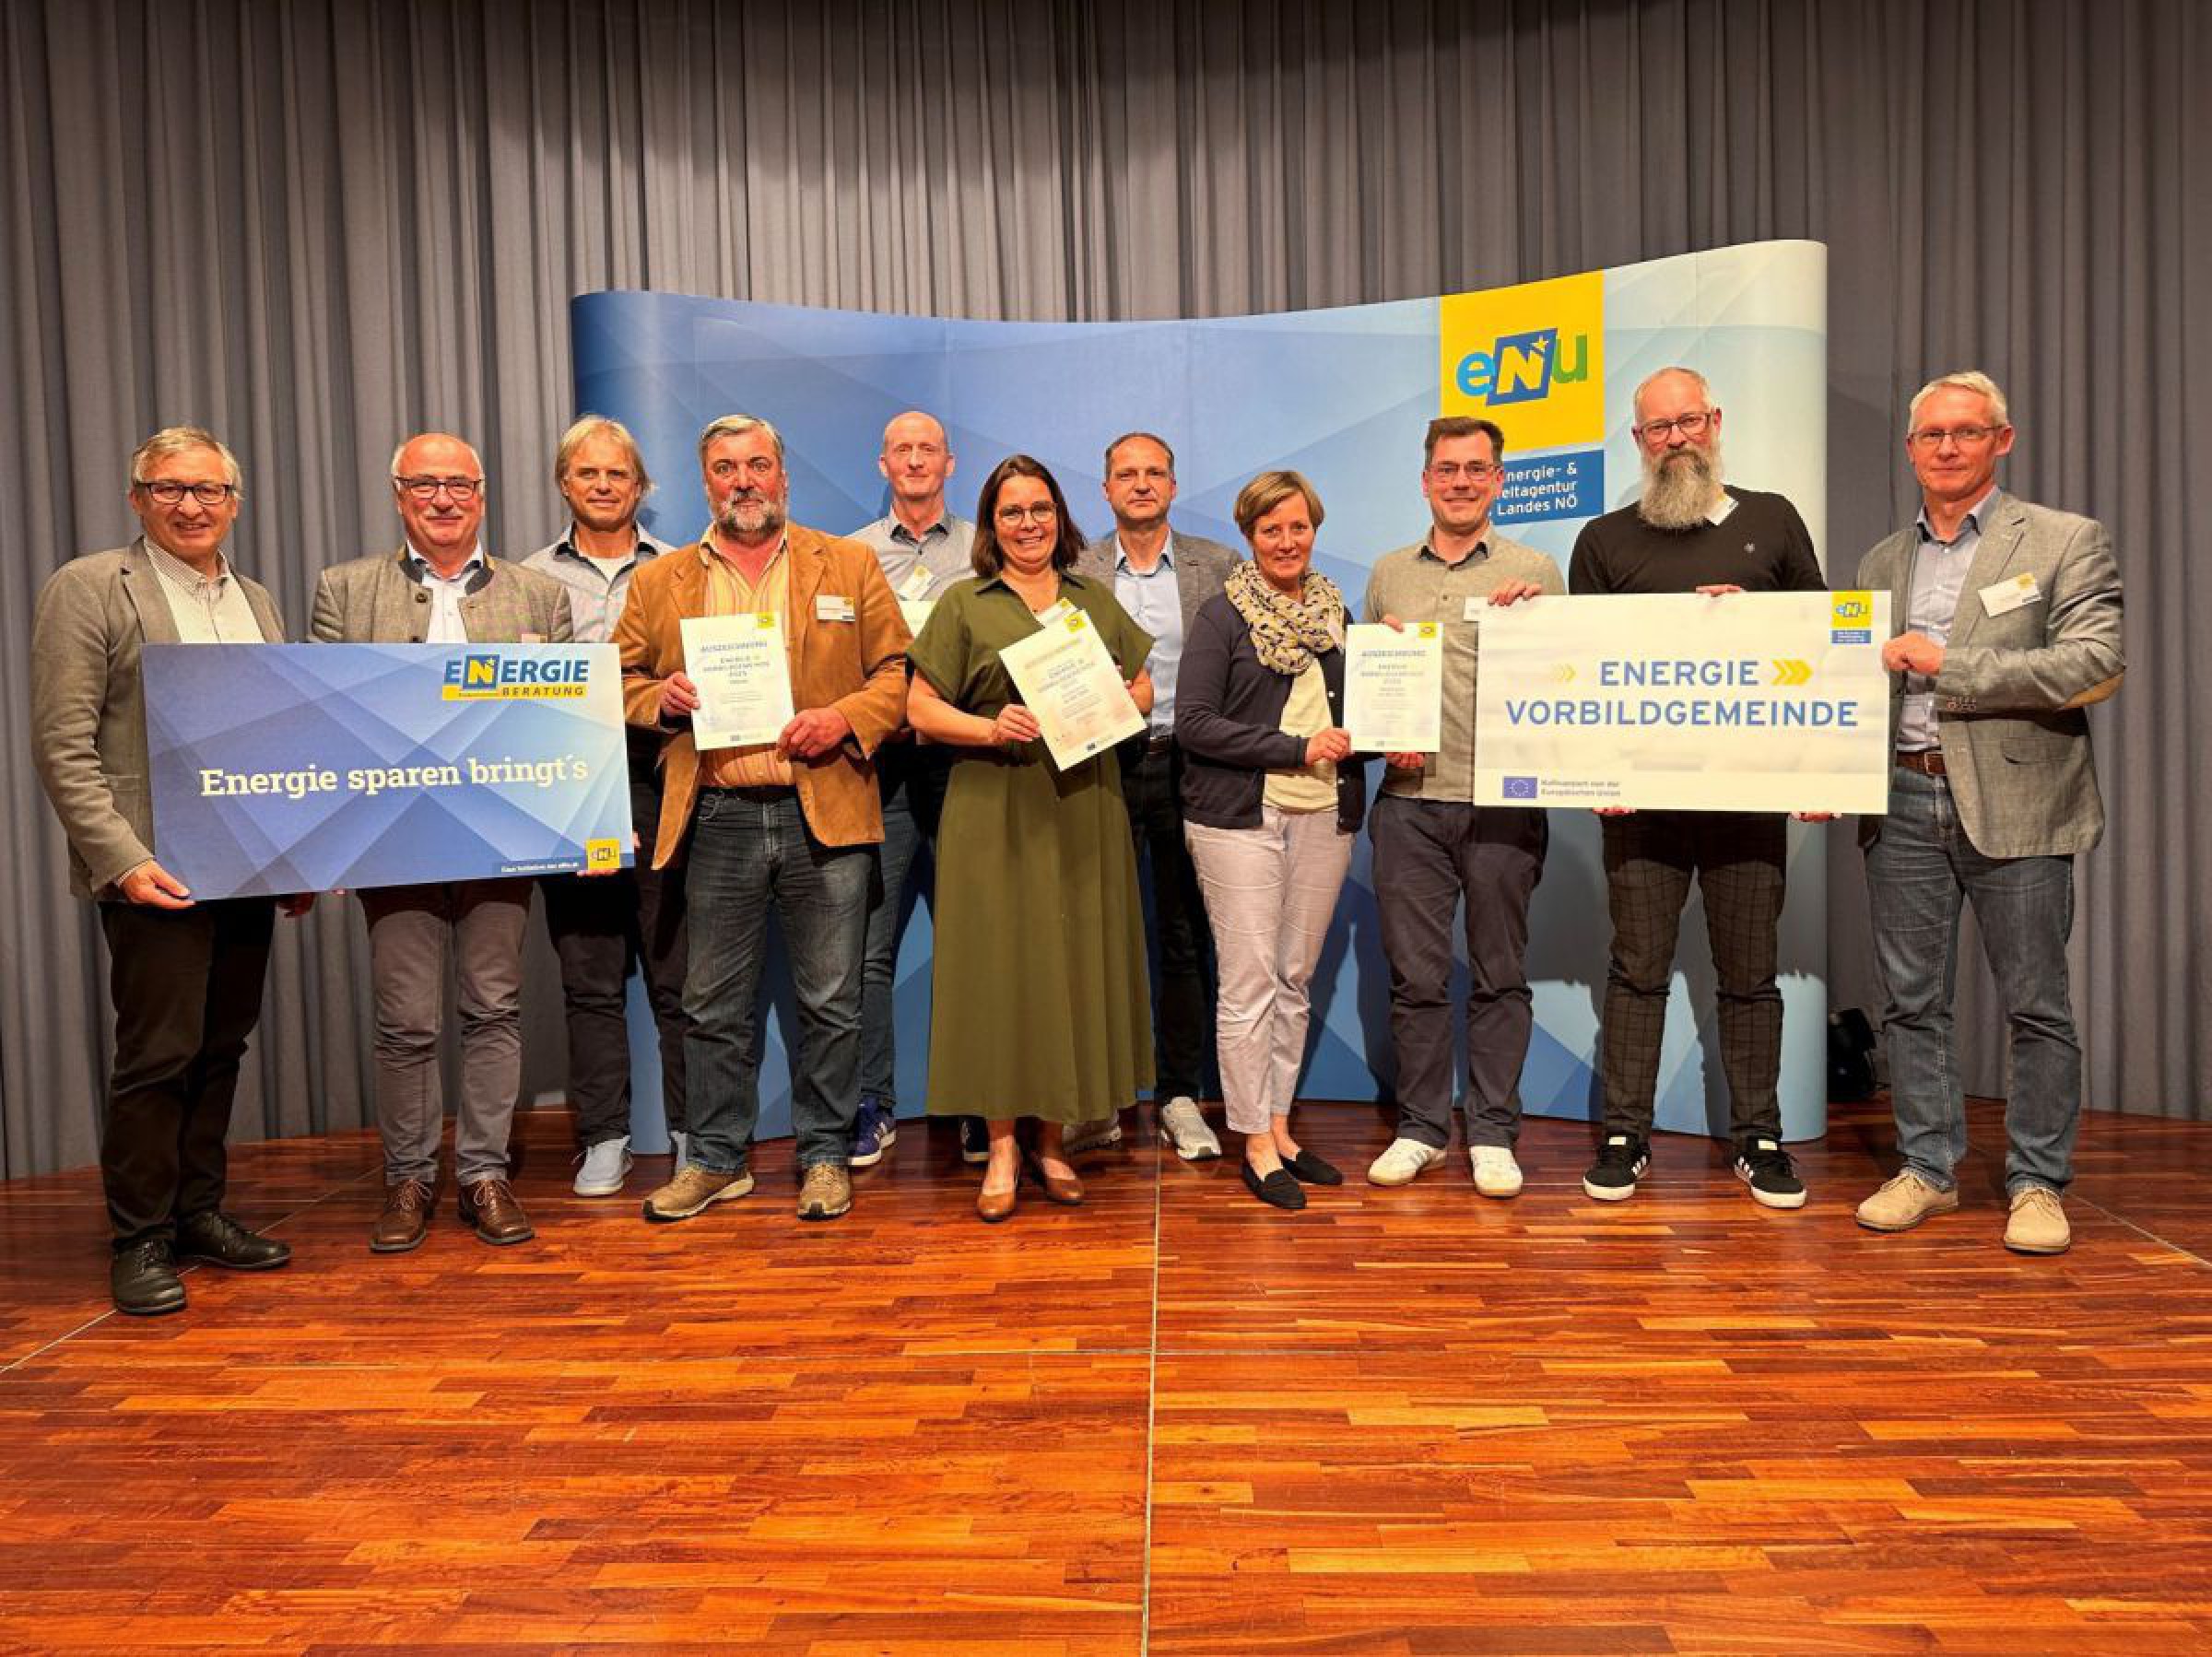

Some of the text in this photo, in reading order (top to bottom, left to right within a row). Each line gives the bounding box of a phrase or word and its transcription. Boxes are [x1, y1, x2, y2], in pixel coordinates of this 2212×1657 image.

[1456, 328, 1588, 405] eNu
[1505, 462, 1577, 482] nergie- &
[1500, 480, 1578, 499] eltagentur
[1497, 495, 1578, 516] Landes NÖ
[443, 654, 589, 688] ENERGIE
[1600, 660, 1759, 686] ENERGIE
[501, 687, 584, 696] BERATUNG
[1506, 700, 1858, 726] VORBILDGEMEINDE
[199, 763, 337, 798] Energie
[347, 764, 461, 794] sparen
